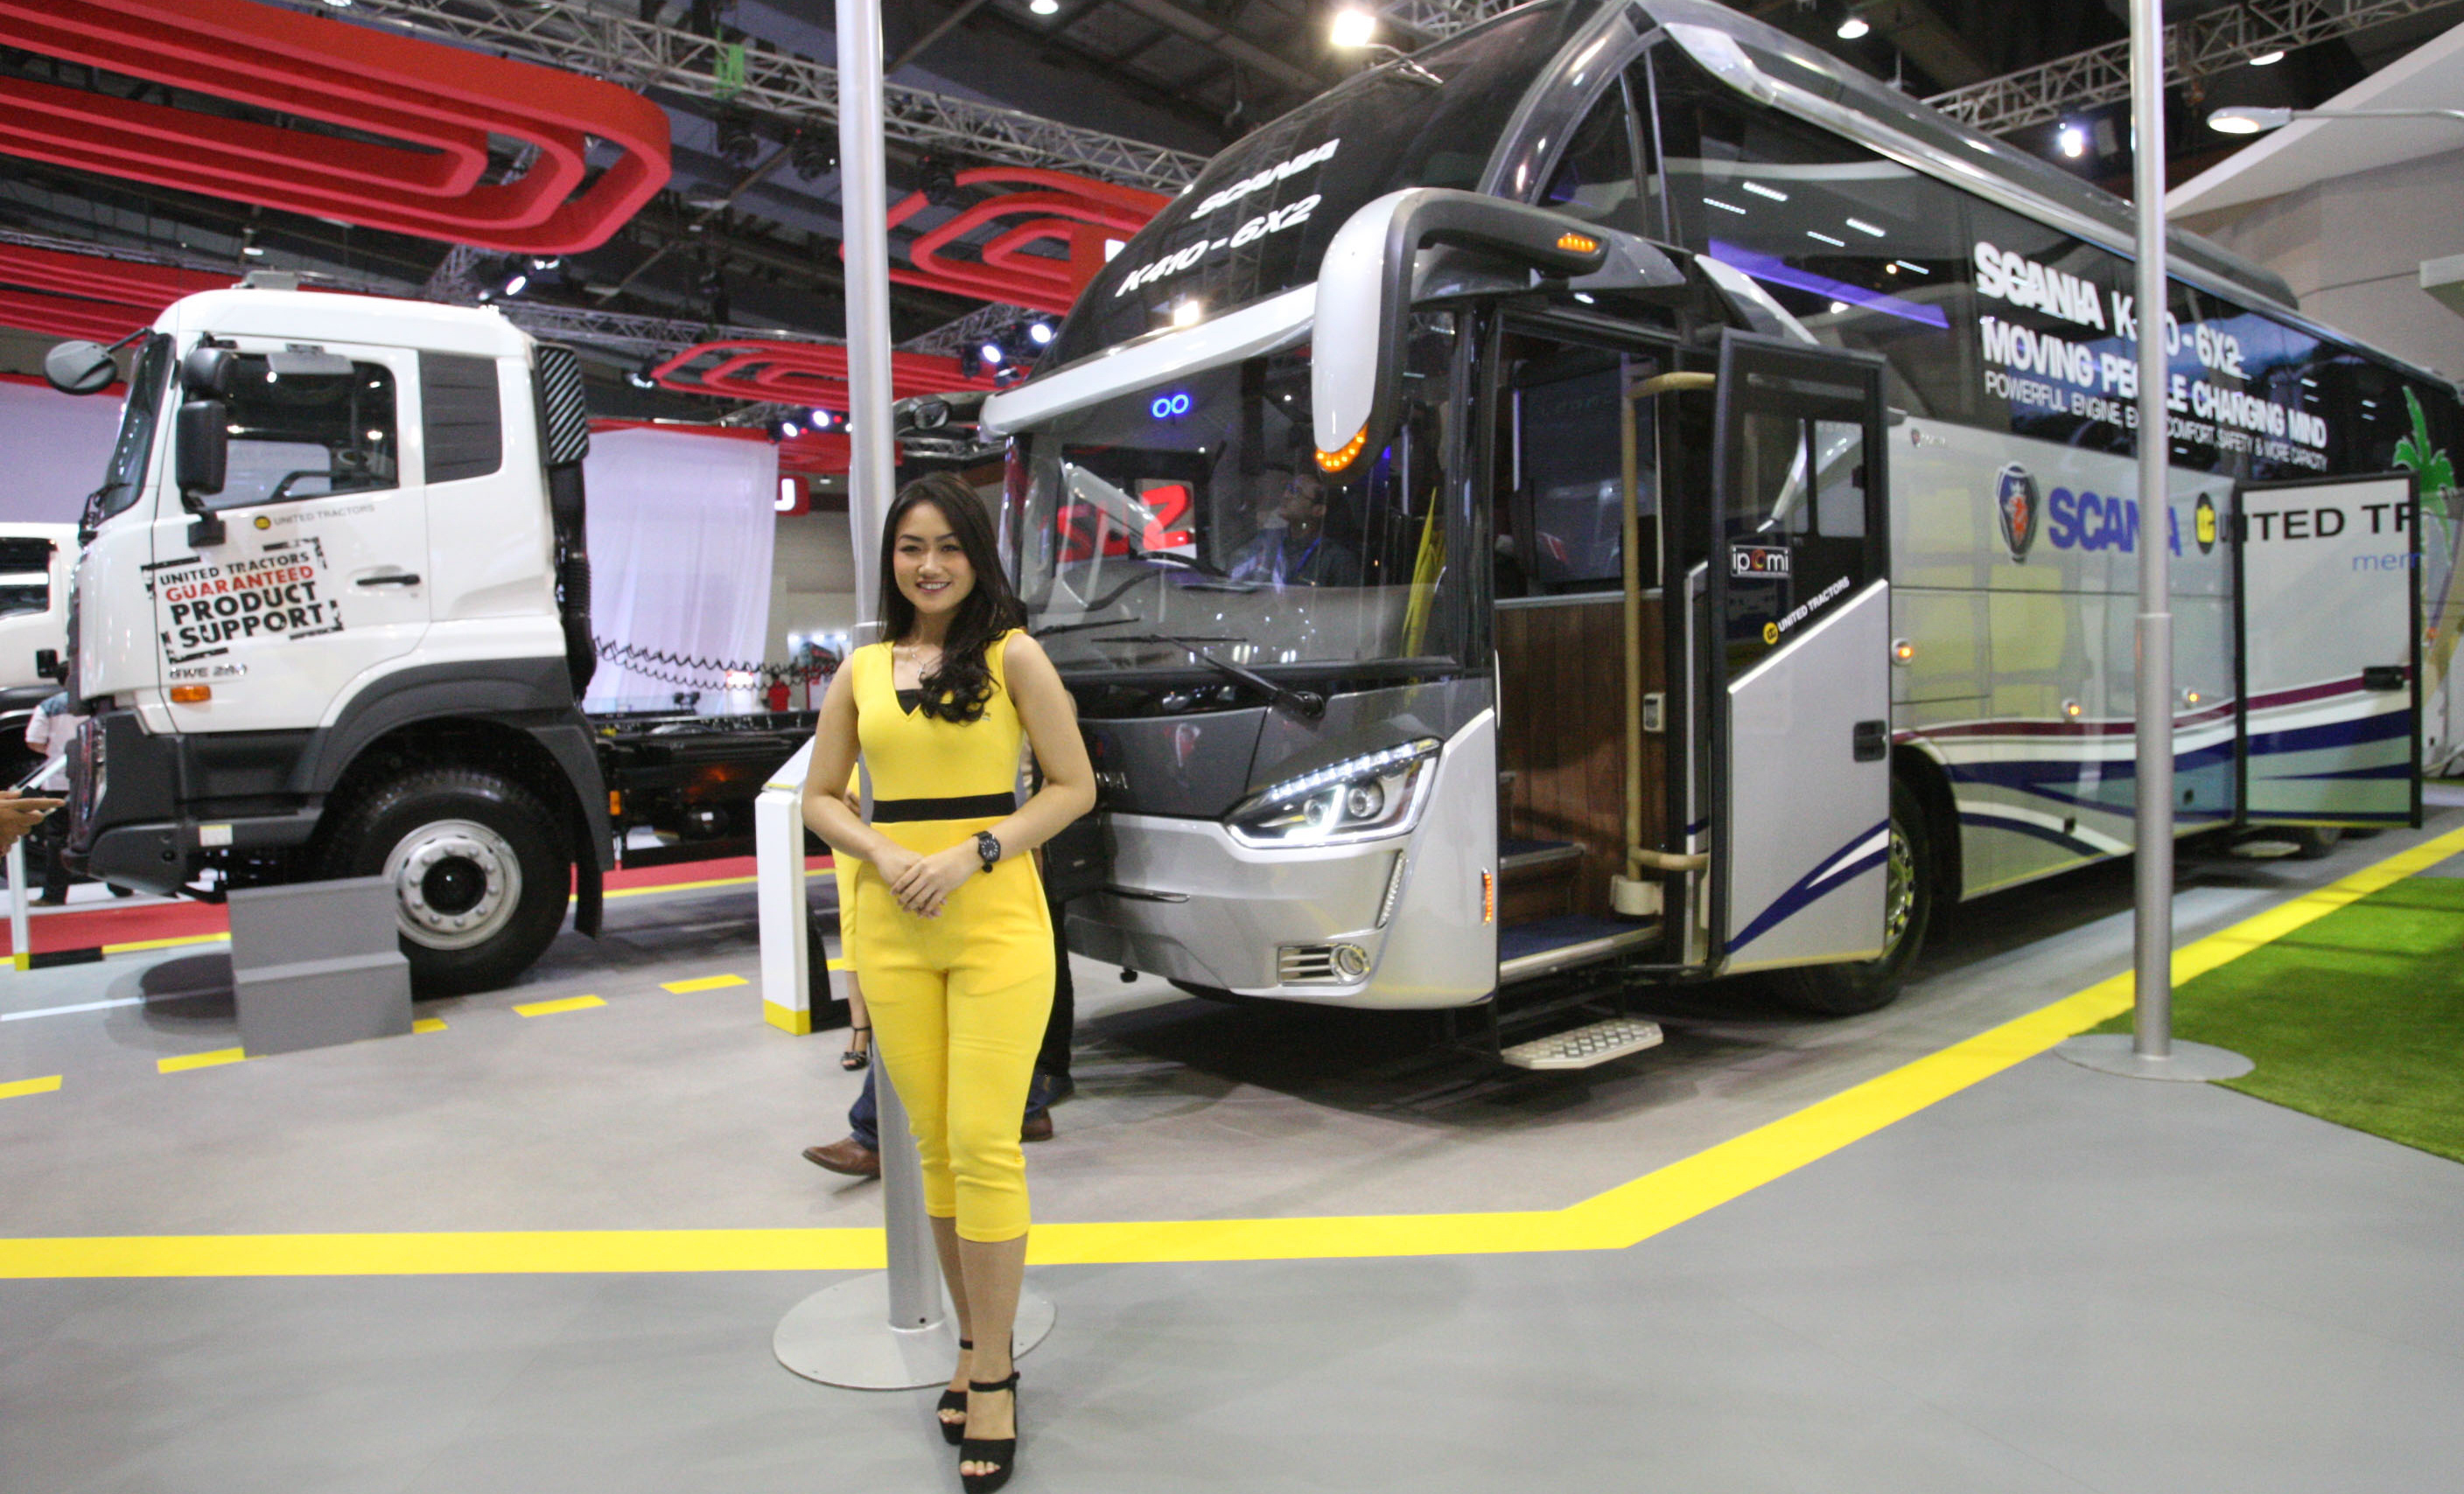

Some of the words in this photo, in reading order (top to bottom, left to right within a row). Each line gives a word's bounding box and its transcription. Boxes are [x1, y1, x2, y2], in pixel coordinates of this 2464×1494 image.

[1190, 137, 1340, 220] SCANIA
[1973, 241, 2106, 332] SCANIA
[1979, 315, 2095, 388] MOVING
[2191, 380, 2286, 437] CHANGING
[2287, 407, 2328, 450] MIND
[1984, 369, 2068, 414] POWERFUL
[273, 512, 316, 527] UNITED
[160, 568, 220, 585] UNITED
[226, 552, 310, 576] TRACTORS
[165, 565, 314, 603] GUARANTEED
[170, 581, 317, 625] PRODUCT
[1777, 604, 1809, 632] UNITED
[1806, 575, 1851, 612] TRACTORS
[179, 604, 323, 649] SUPPORT
